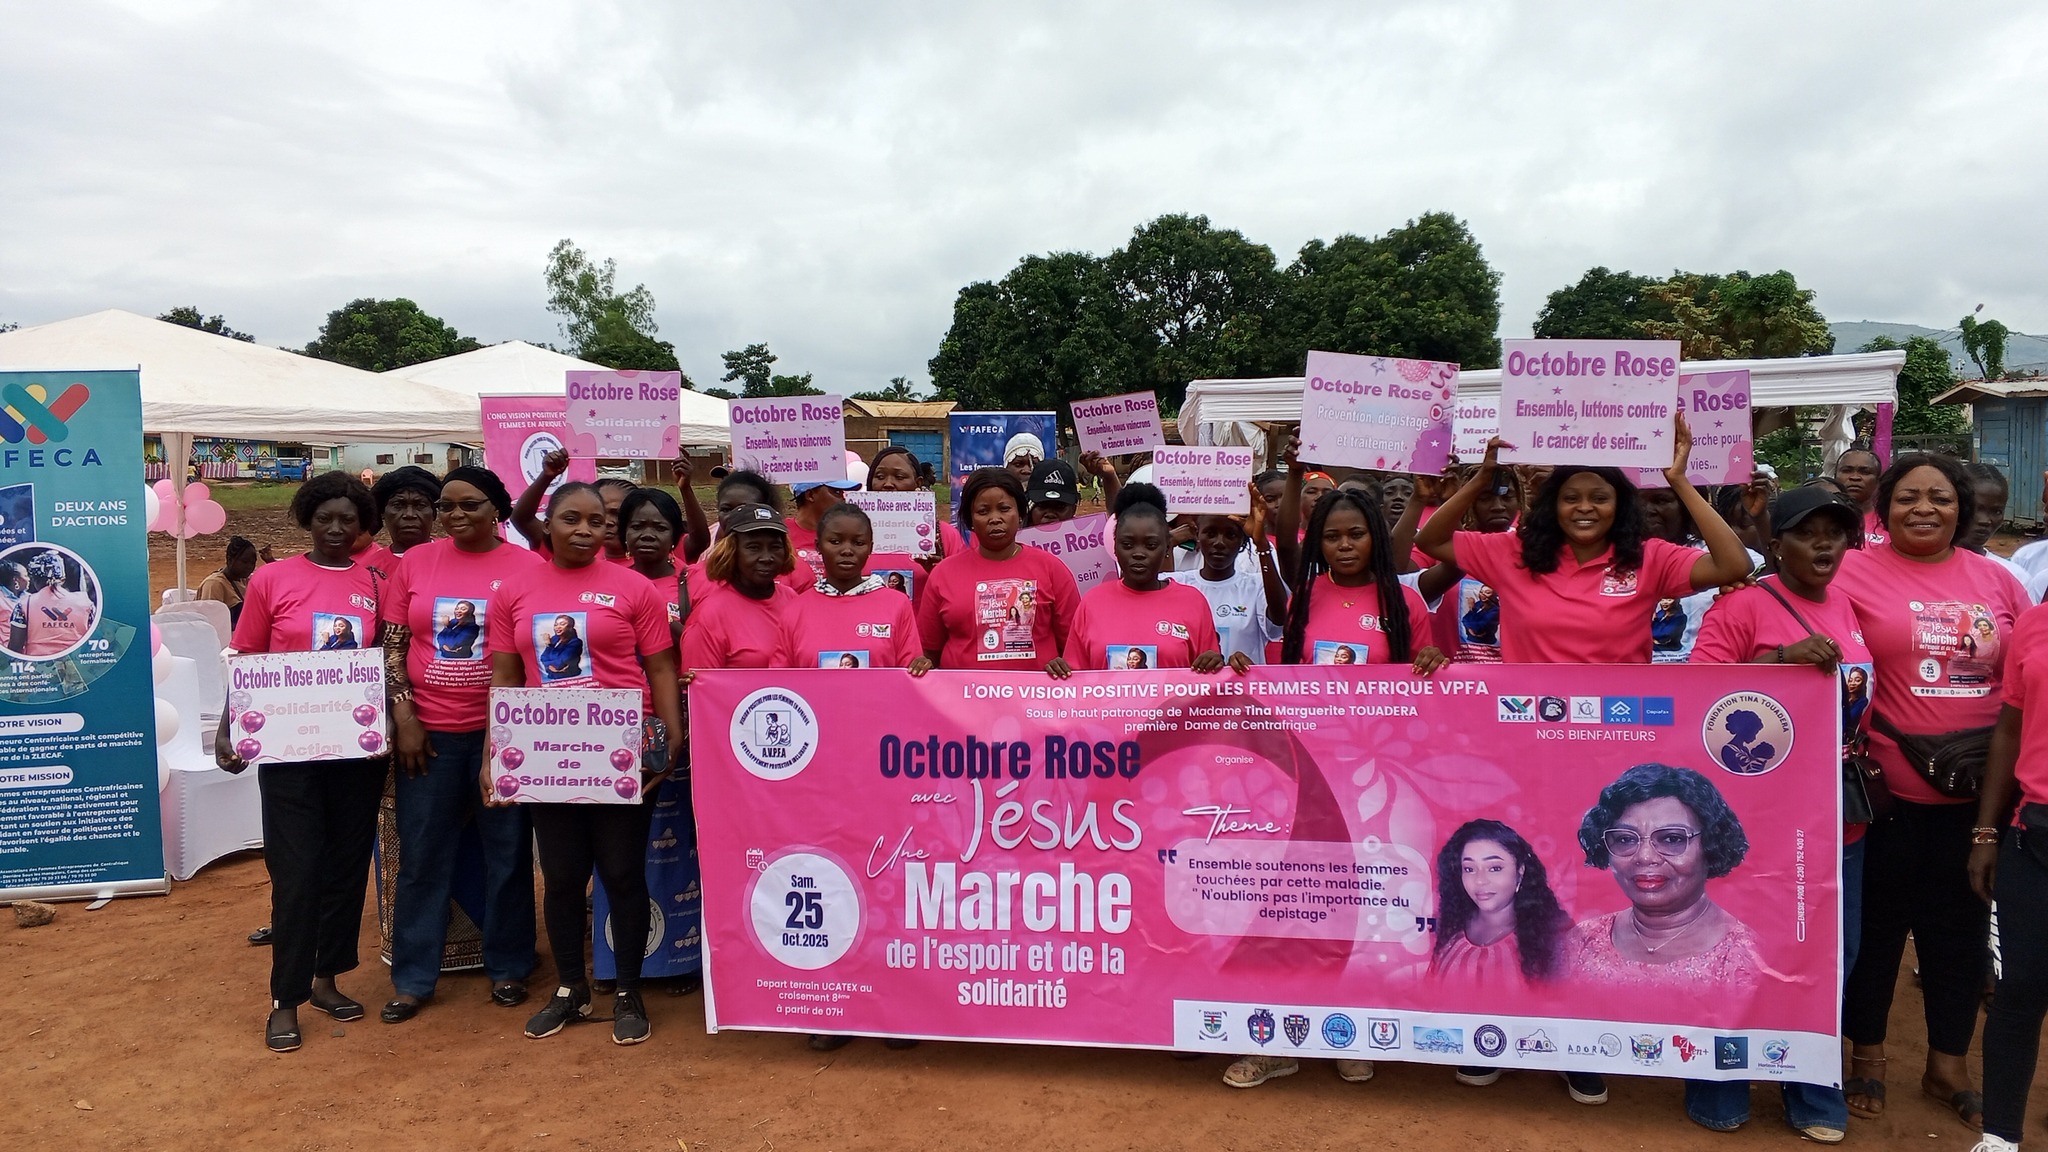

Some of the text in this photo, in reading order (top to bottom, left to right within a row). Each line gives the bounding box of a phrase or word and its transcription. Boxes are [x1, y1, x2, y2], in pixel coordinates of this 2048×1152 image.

[1508, 350, 1676, 377] Octobre Rose
[569, 382, 678, 401] Octobre Rose
[1310, 377, 1433, 400] Octobre Rose
[1693, 389, 1748, 412] Rose
[508, 412, 531, 420] VISION
[732, 403, 841, 424] Octobre Rose
[1073, 399, 1155, 419] Octobre Rose
[1516, 399, 1667, 421] Ensemble, luttons contre
[499, 421, 526, 430] FEMMES
[585, 418, 661, 428] Solidarité
[613, 433, 632, 442] en
[745, 434, 832, 451] Ensemble, nous vaincrons
[1337, 434, 1347, 446] et
[1532, 431, 1544, 449] le
[1547, 436, 1589, 450] cancer
[1592, 431, 1607, 450] de
[1721, 433, 1743, 448] pour
[597, 447, 648, 457] Action
[1155, 450, 1251, 465] Octobre Rose
[770, 458, 818, 472] cancer de sein
[1690, 457, 1718, 471] vies...
[1160, 476, 1247, 488] Ensemble, luttons contre
[877, 499, 933, 511] Rose avec Jésus
[1169, 494, 1175, 503] le
[1178, 495, 1202, 504] cancer
[1203, 494, 1212, 504] de
[54, 500, 127, 513] DEUX ANS
[51, 515, 128, 527] D'ACTIONS
[1078, 569, 1099, 582] sein
[89, 639, 109, 650] 70
[1922, 632, 1958, 645] Marche
[78, 651, 115, 660] entreprises
[10, 661, 36, 673] 114
[1926, 666, 1934, 674] 25
[233, 661, 380, 690] Octobre Rose avec Jésus
[964, 681, 1490, 699] L'ONG VISION POSITIVE POUR LES FEMMES EN AFRIQUE VPFA
[264, 699, 353, 716] Solidarité
[495, 701, 639, 726] Octobre Rose
[1026, 705, 1419, 721] Sous le haut patronage de Madame Tina Marguerite TOUADERA
[1707, 695, 1789, 733] FONDATION TINA TOUADERA
[27, 718, 62, 728] VISION
[297, 723, 320, 735] en
[1124, 719, 1317, 734] première Dame de Centrafrique
[24, 731, 144, 744] Centrafricaine soit compétitive
[1537, 729, 1656, 741] NOS BIENFAITEURS
[29, 740, 143, 754] gagner parts marchés
[283, 742, 343, 757] Action
[533, 740, 605, 752] Marche
[31, 752, 64, 760] ZLECAF.
[879, 734, 1141, 780] Octobre Rose
[1215, 755, 1254, 765] Organise
[557, 759, 581, 769] de
[28, 772, 70, 781] MISSION
[520, 775, 613, 787] Solidarité
[22, 783, 143, 797] entrepreneures Centrafricaines
[911, 778, 1143, 862] avec Jésus
[866, 826, 930, 878] Une
[1188, 859, 1409, 876] Ensemble soutenons les femmes
[791, 875, 817, 889] Sam.
[1196, 874, 1385, 891] touchées par cette maladie.
[904, 862, 1132, 934] Marche
[1273, 893, 1298, 905] pas
[1302, 891, 1388, 908] l'importance
[1391, 896, 1410, 908] du
[785, 891, 824, 930] 25
[1259, 906, 1327, 922] depistage
[782, 932, 829, 948] Oct.2025
[886, 936, 1125, 975] de l'espoir et de la
[756, 979, 873, 993] Depart terrain UCATEX au
[957, 976, 1068, 1009] solidarité
[779, 991, 829, 1003] croisement
[776, 1004, 844, 1017] à partir de 07H
